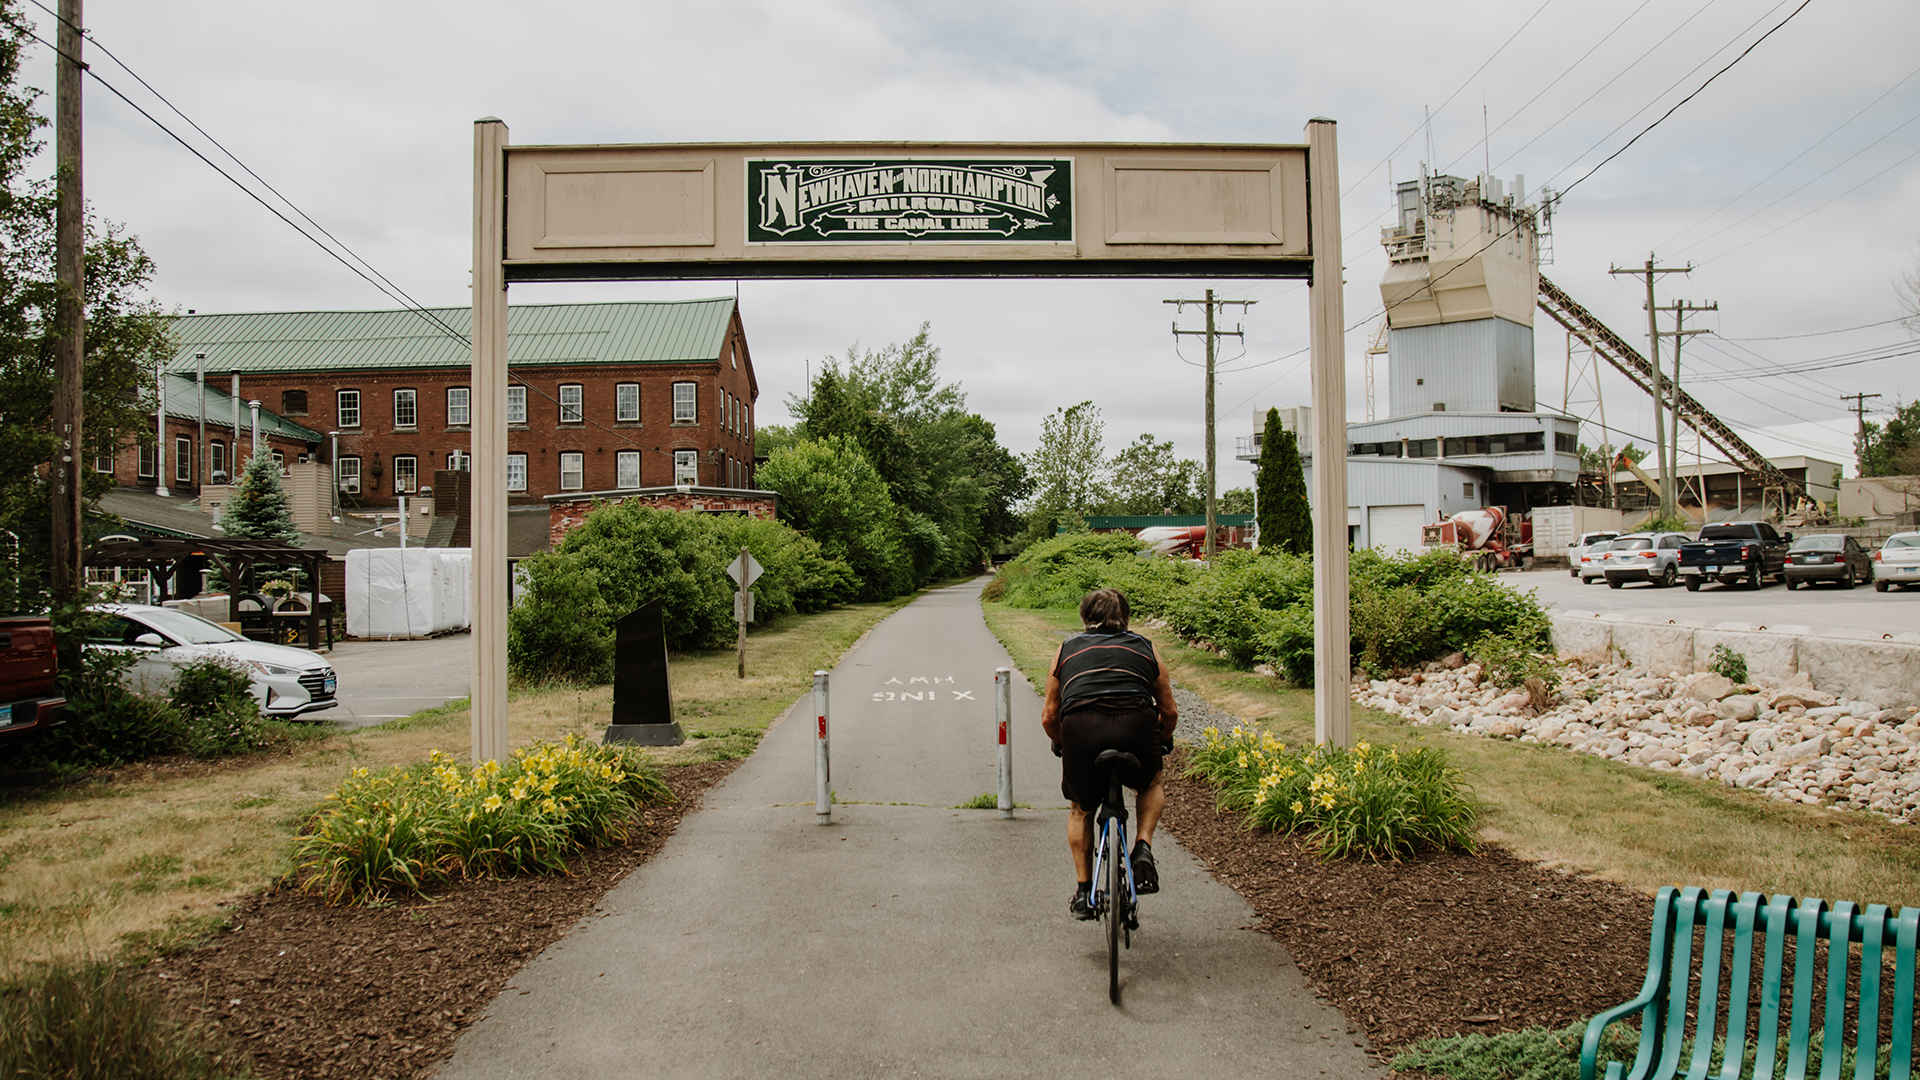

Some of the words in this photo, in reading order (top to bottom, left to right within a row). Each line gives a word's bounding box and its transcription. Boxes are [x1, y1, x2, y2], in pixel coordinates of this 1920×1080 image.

[903, 167, 1042, 212] NORTHAMPTON
[858, 197, 975, 213] RAILROAD
[845, 217, 879, 230] THE
[884, 217, 945, 230] CANAL
[951, 217, 989, 230] LINE
[951, 690, 976, 701] X
